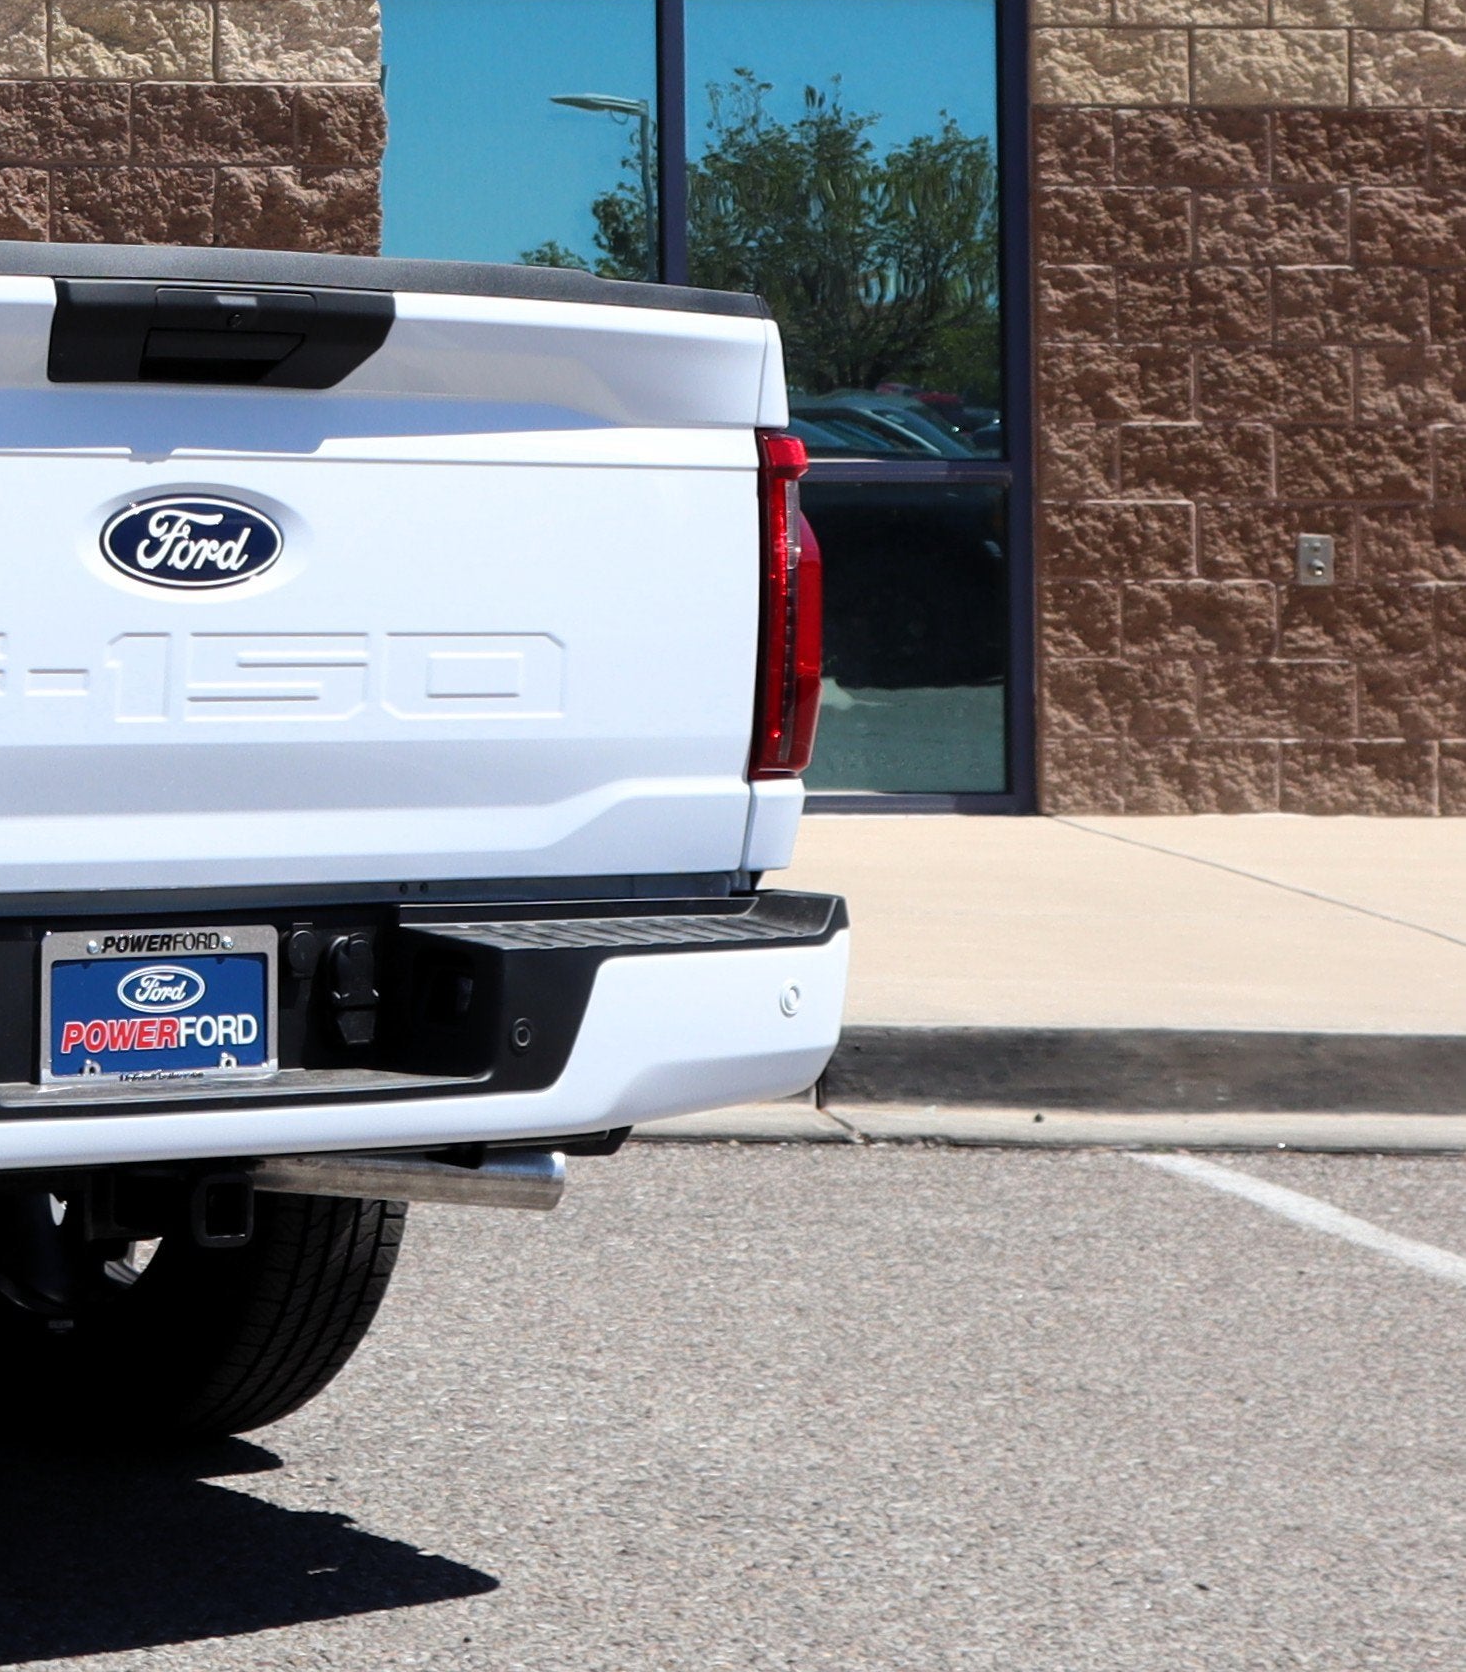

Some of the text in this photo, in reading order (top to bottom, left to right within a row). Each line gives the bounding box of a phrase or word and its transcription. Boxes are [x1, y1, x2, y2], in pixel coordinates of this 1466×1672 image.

[136, 509, 250, 571] Ford
[135, 974, 187, 1003] Ford
[61, 1013, 257, 1054] POWERFORD
